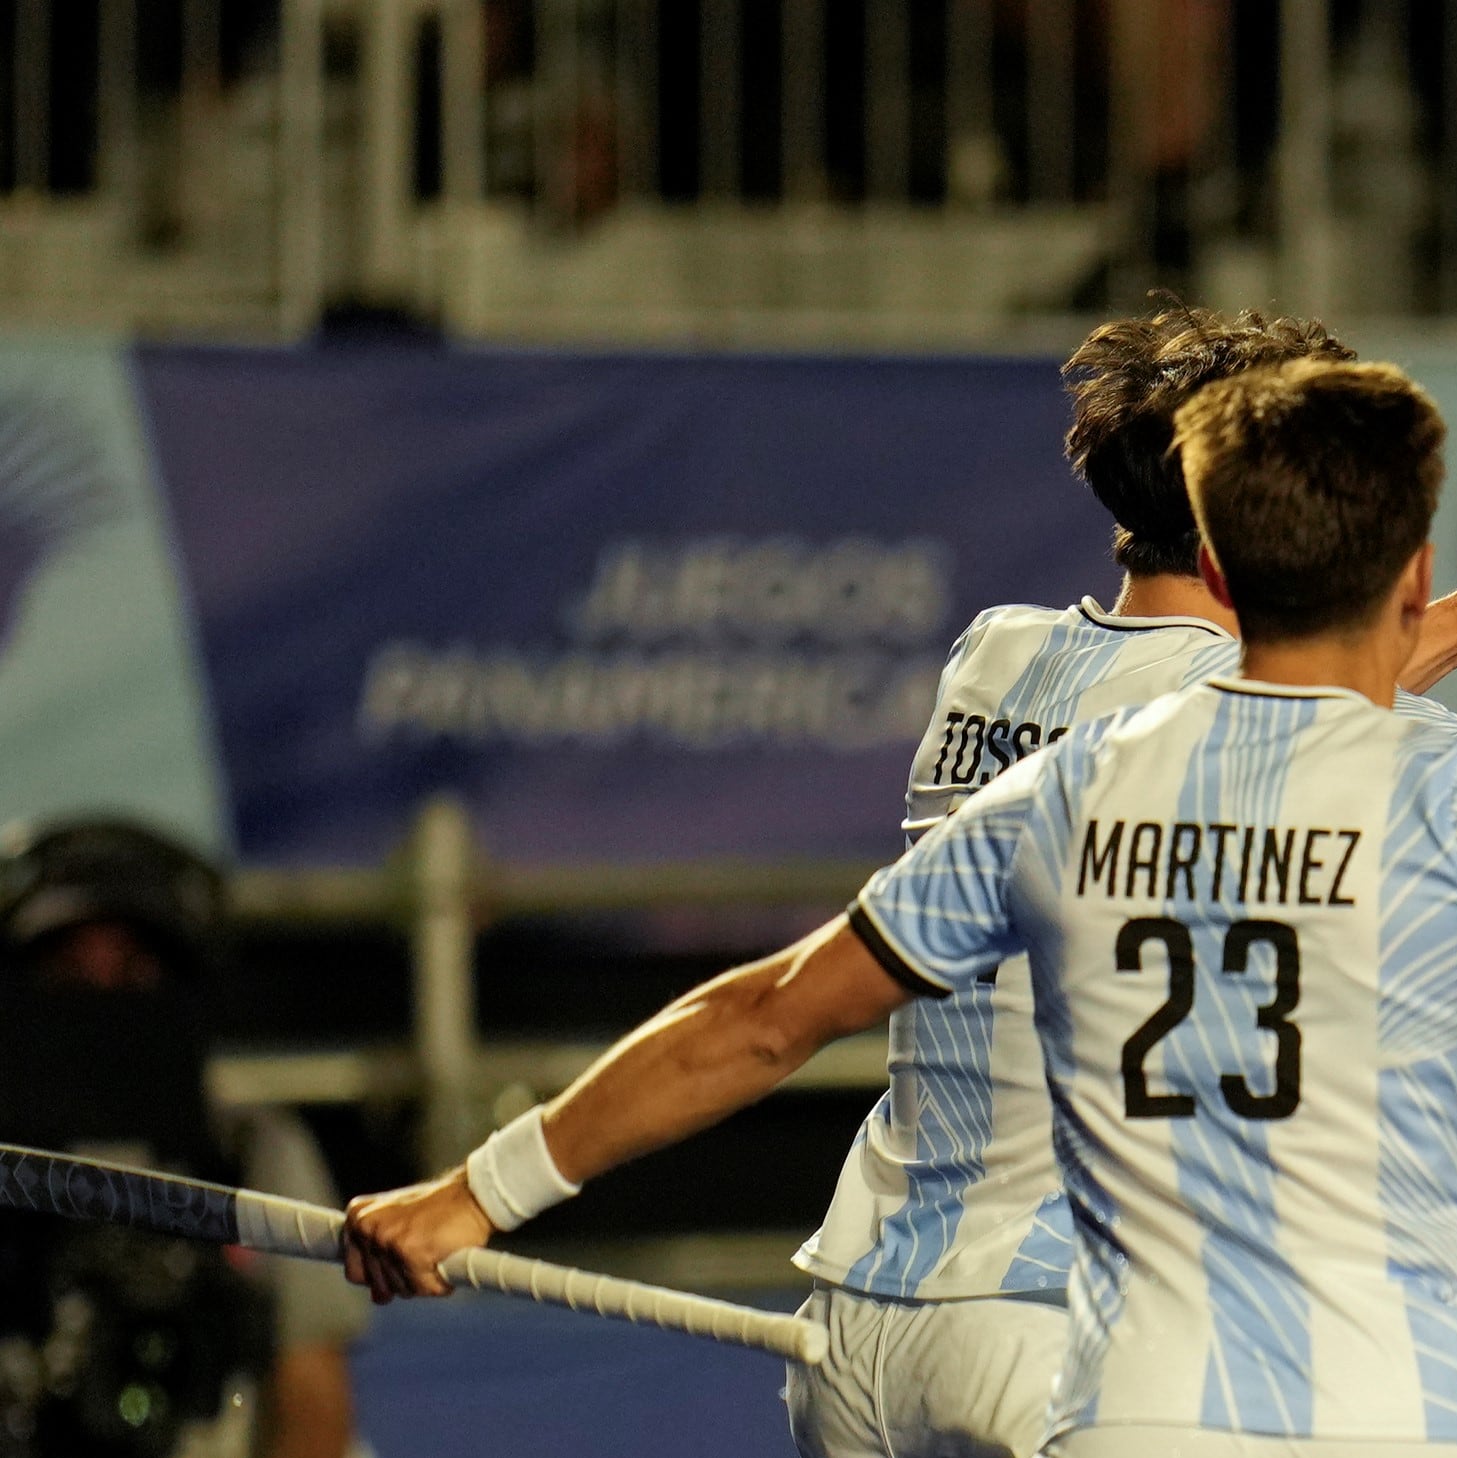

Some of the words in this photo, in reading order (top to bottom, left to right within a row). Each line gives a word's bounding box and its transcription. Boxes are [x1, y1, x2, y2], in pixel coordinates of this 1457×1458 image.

[933, 711, 1070, 786] TOSC
[1077, 819, 1362, 907] MARTINEZ
[1114, 916, 1303, 1121] 23
